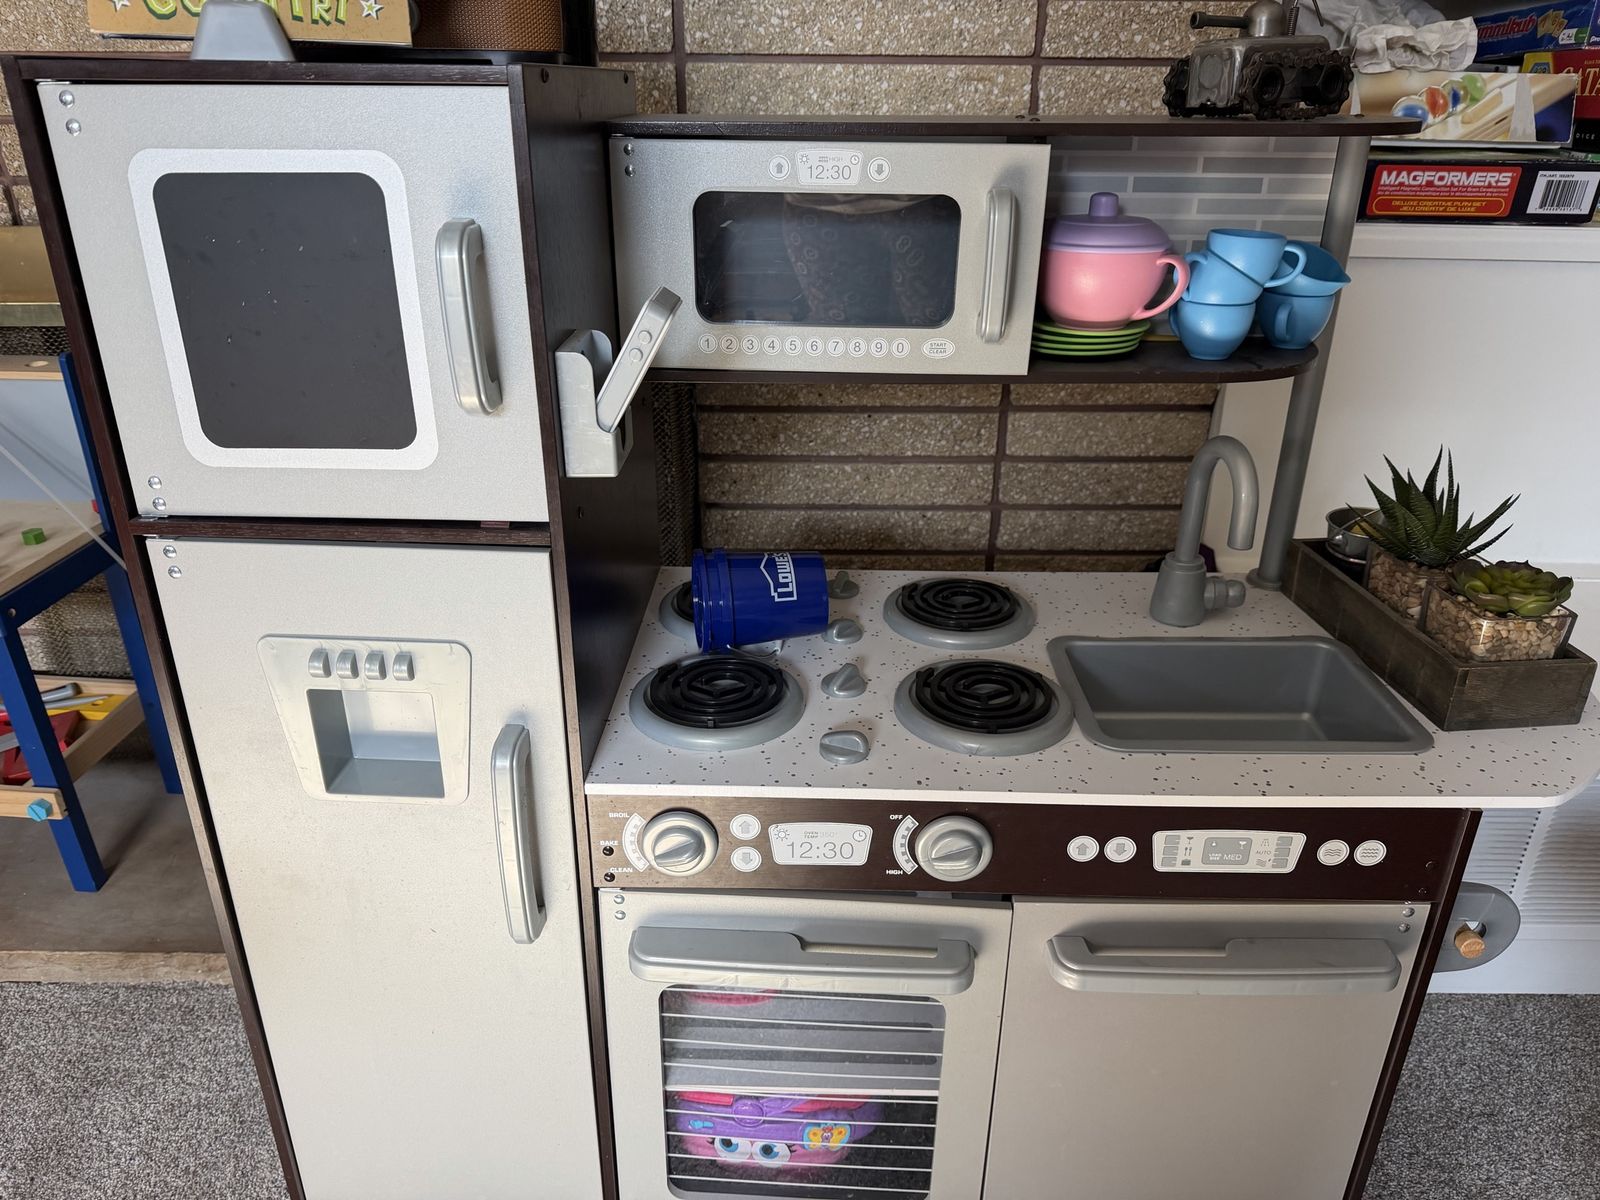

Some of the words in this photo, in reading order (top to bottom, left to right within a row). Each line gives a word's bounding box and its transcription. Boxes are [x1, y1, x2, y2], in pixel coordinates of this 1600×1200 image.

[807, 164, 852, 180] 12:30
[1380, 170, 1513, 187] MAGFORMERS
[704, 338, 710, 349] 1
[725, 338, 733, 350] 2
[746, 339, 754, 350] 3
[768, 340, 775, 351] 4
[789, 340, 797, 351] 5
[810, 340, 818, 352] 6
[832, 341, 840, 352] 7
[853, 341, 861, 352] 8
[875, 342, 883, 353] 9
[896, 342, 904, 353] 0
[786, 841, 854, 860] 12:30
[1223, 853, 1242, 861] MED
